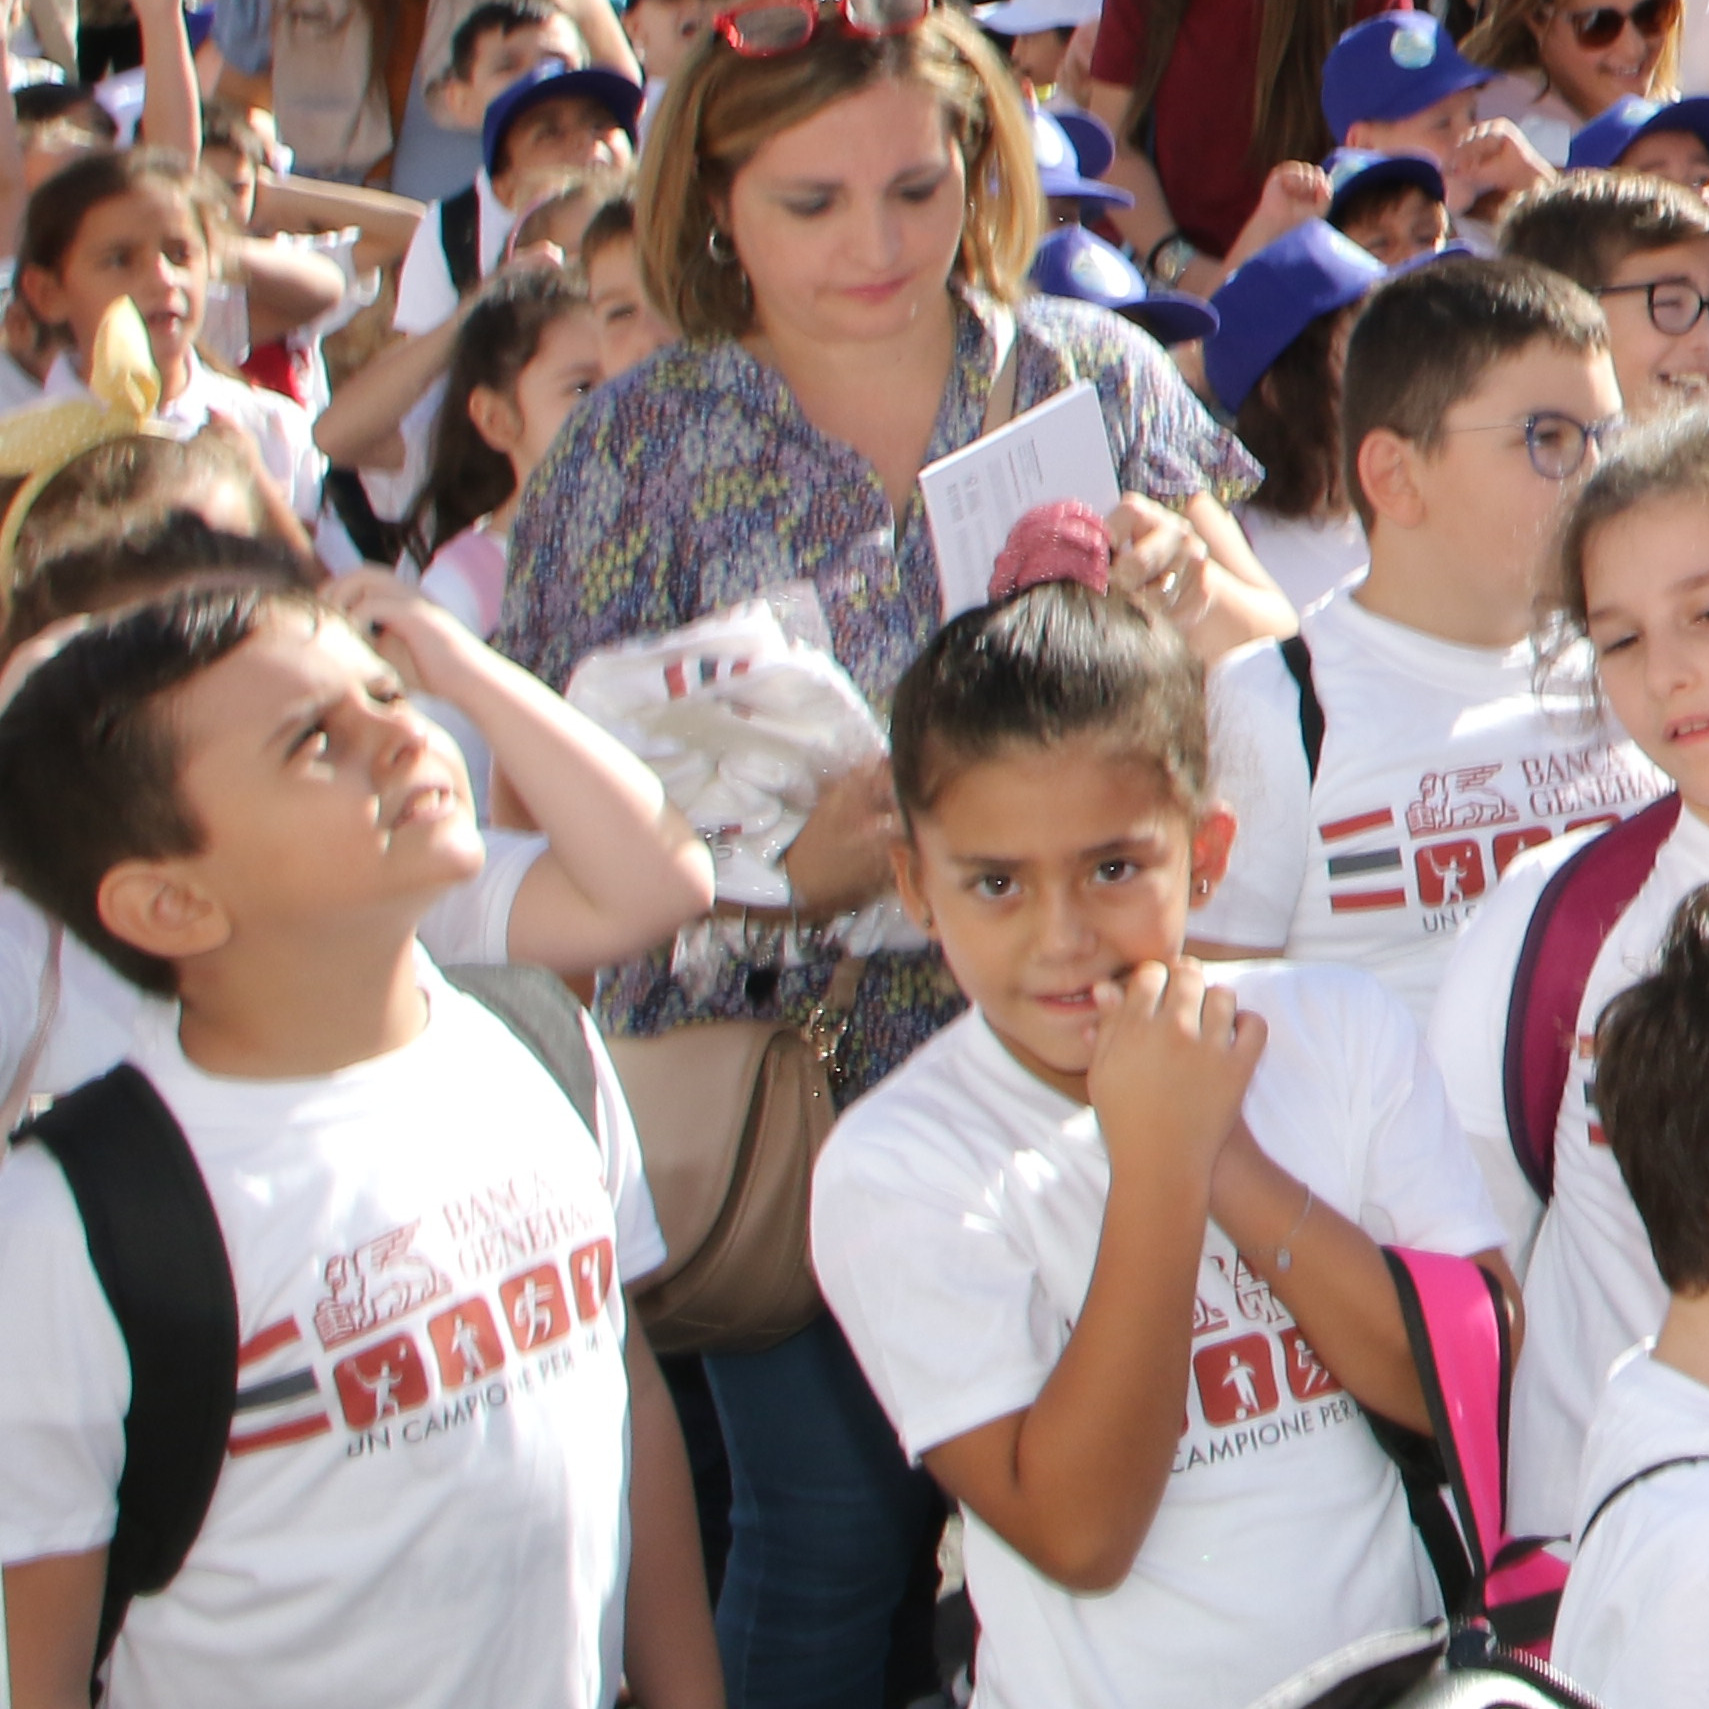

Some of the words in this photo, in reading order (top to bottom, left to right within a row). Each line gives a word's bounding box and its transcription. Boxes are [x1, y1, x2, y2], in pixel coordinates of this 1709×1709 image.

[1422, 911, 1457, 933] UN
[1320, 1398, 1351, 1426] PER
[347, 1426, 392, 1458] UN
